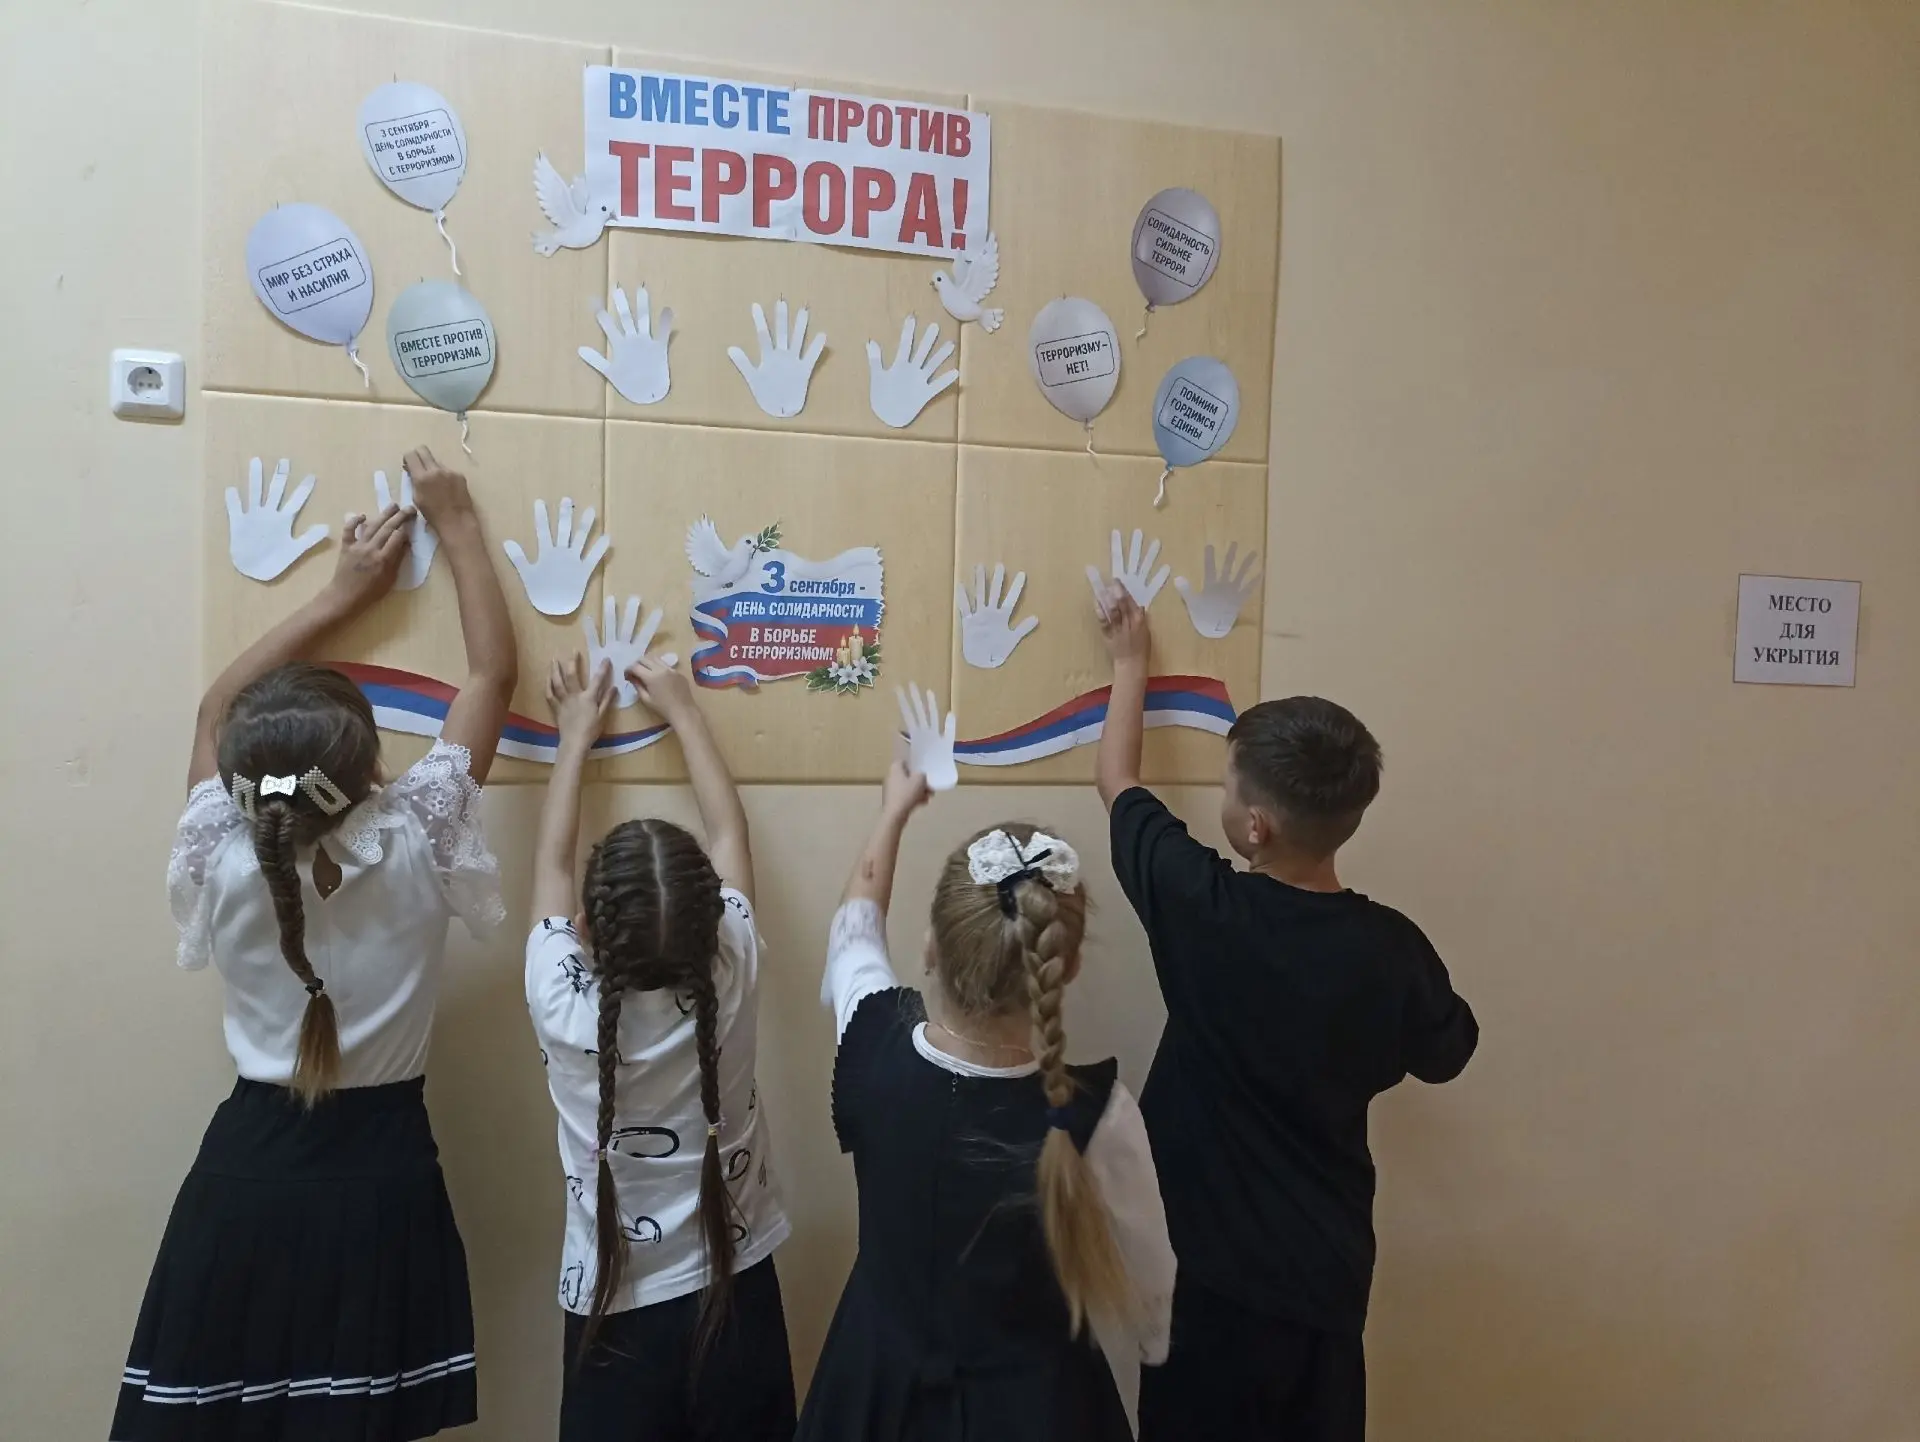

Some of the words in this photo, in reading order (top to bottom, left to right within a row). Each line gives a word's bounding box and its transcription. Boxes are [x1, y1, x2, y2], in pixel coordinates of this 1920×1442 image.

[609, 72, 791, 135] ВМЕСТЕ
[807, 95, 971, 158] ПРОТИВ
[375, 142, 394, 152] ДЕНЬ
[395, 128, 451, 148] СОЛИДАРНОСТИ
[380, 129, 387, 137] 3
[388, 119, 429, 137] СЕНТЯБРЯ
[389, 166, 395, 175] С
[397, 154, 454, 174] ТЕРРОРИЗМОМ
[397, 152, 404, 161] В
[405, 145, 436, 159] БОРЬБЕ
[608, 139, 969, 251] ТЕРРОРА!
[1147, 216, 1210, 255] СОЛИДАРНОСТЬ
[1155, 237, 1192, 262] СИЛЬНЕЕ
[266, 273, 290, 289] МИР
[292, 264, 312, 281] БЕЗ
[313, 248, 353, 272] СТРАХА
[1151, 250, 1186, 276] ТЕРРОРА
[287, 290, 298, 302] И
[299, 268, 350, 298] НАСИЛИЯ
[400, 336, 441, 353] ВМЕСТЕ
[444, 328, 483, 345] ПРОТИВ
[412, 346, 481, 368] ТЕРРОРИЗМА
[1066, 360, 1089, 375] НЕТ!
[1180, 386, 1218, 415] ПОМНИМ
[1170, 398, 1215, 431] ГОРДИМСЯ
[1170, 415, 1202, 440] ЕДИНЫ
[760, 560, 785, 594] 3
[789, 578, 856, 597] сентября
[732, 601, 766, 618] ДЕНЬ
[769, 602, 864, 619] СОЛИДАРНОСТИ
[1768, 594, 1832, 613] МЕСТО
[750, 627, 760, 643] В
[763, 628, 816, 644] БОРЬБЕ
[1779, 622, 1815, 640] ДЛЯ
[730, 645, 738, 659] С
[741, 645, 833, 661] ТЕРРОРИЗМОМ!
[1753, 647, 1840, 666] УКРЫТИЯ
